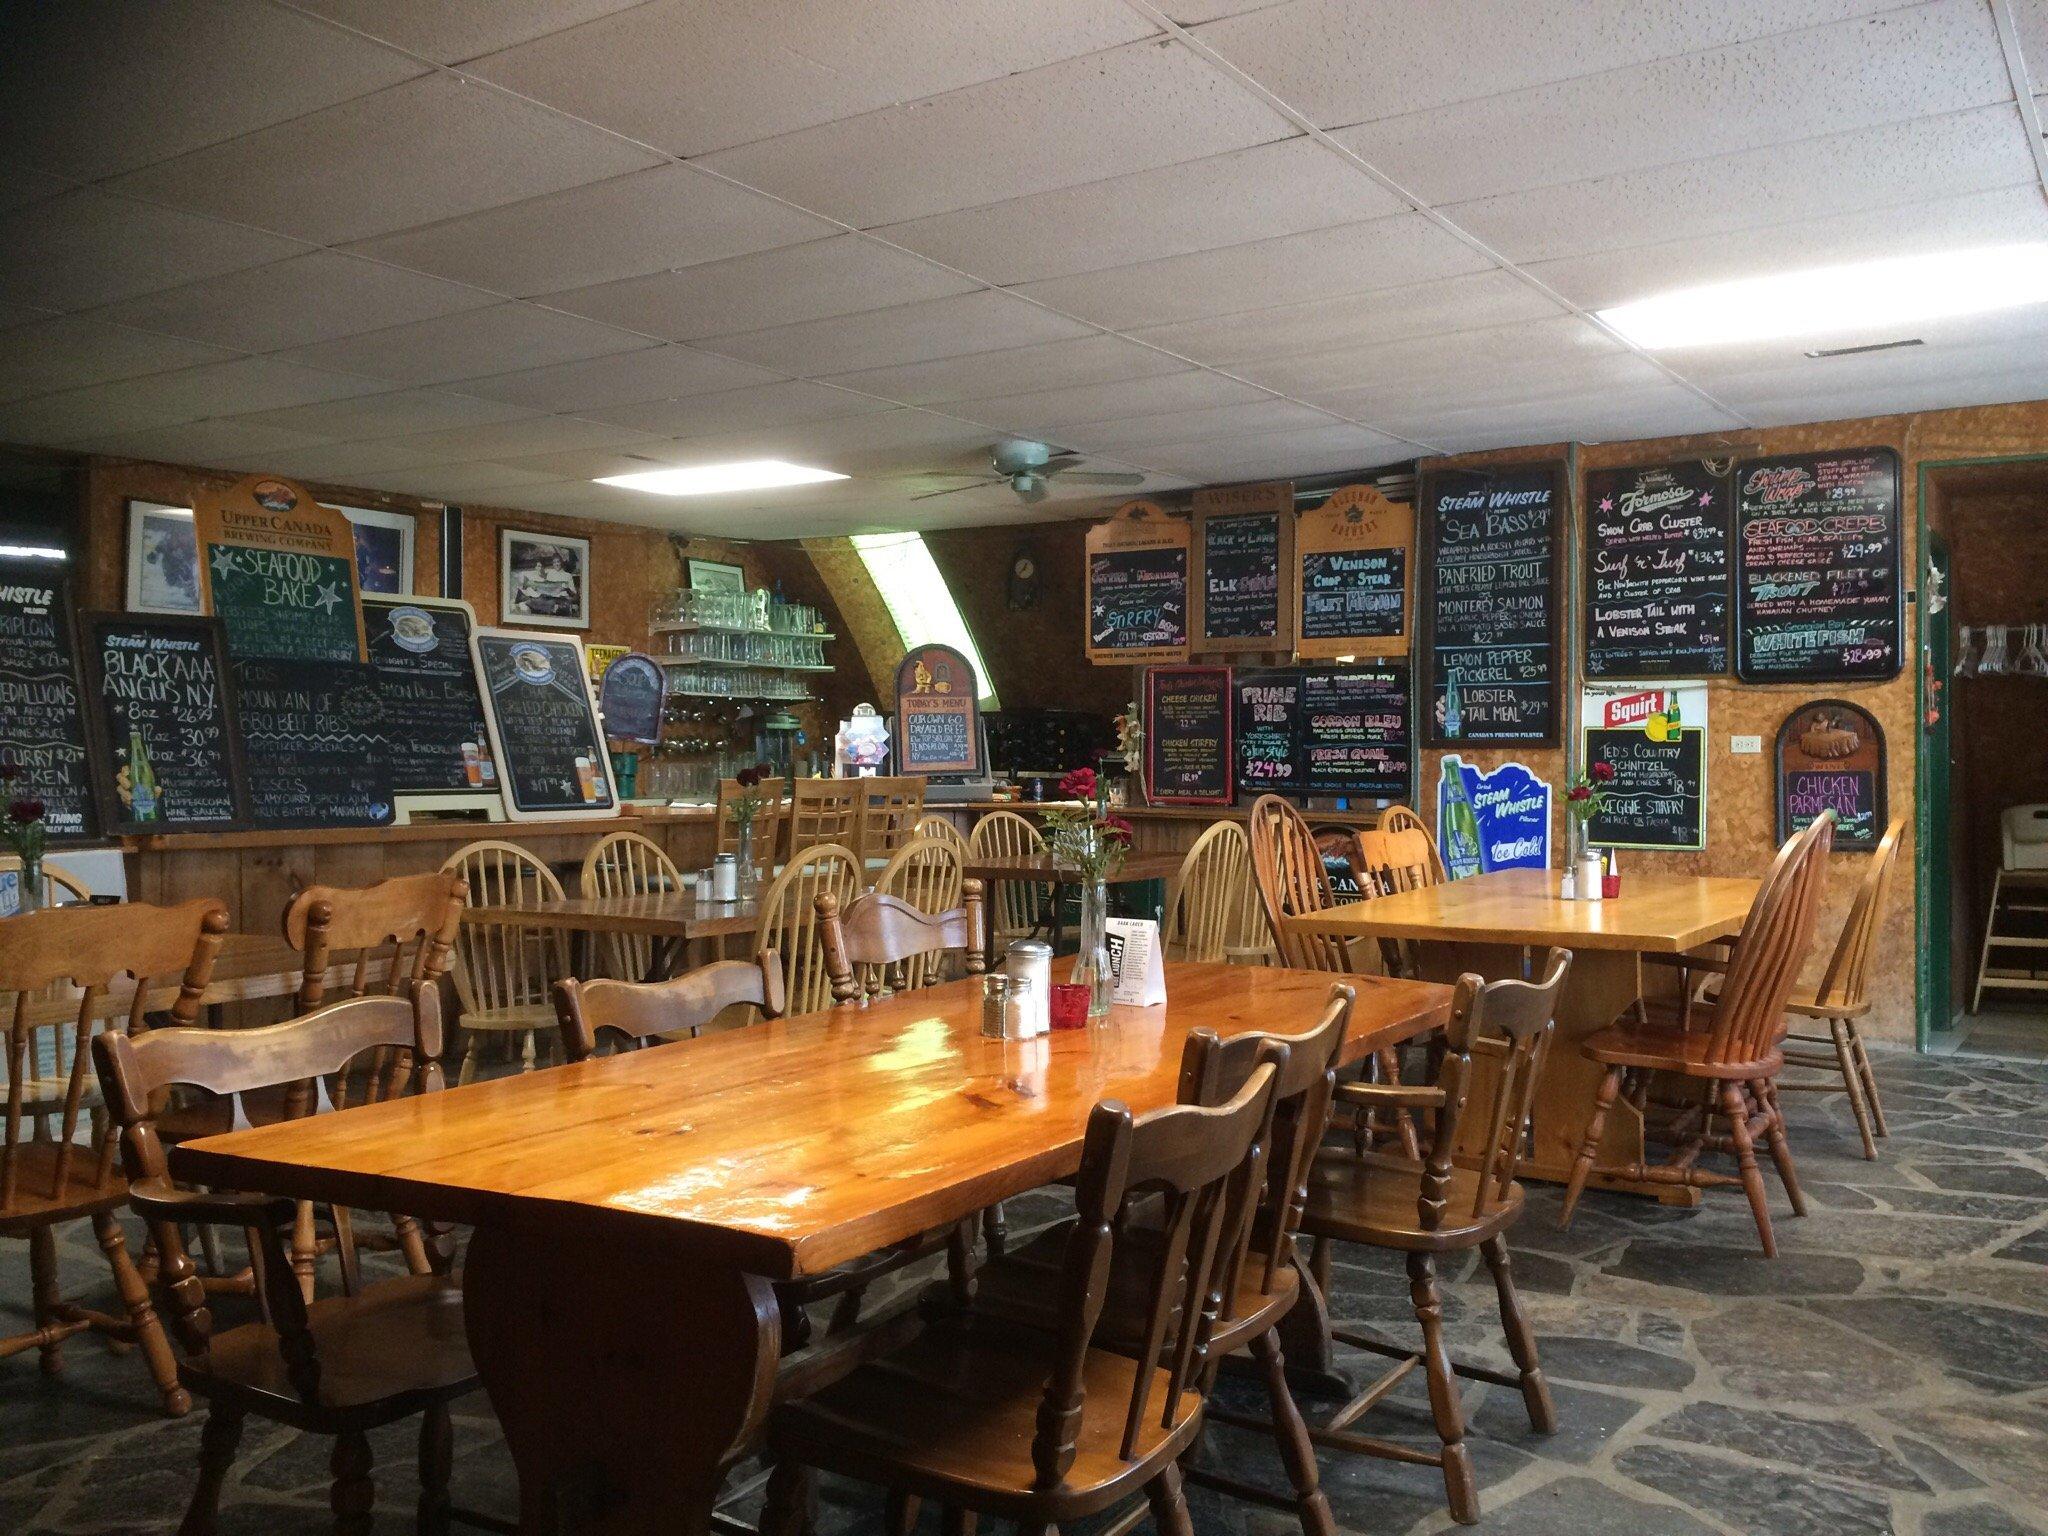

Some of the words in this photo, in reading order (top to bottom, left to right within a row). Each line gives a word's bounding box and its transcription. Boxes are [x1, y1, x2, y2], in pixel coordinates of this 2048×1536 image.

[1439, 495, 1485, 512] STEAM
[1490, 489, 1553, 508] WHISTLE
[1620, 486, 1695, 517] Formosa
[222, 510, 268, 529] UPPER
[271, 516, 333, 536] CANADA
[1443, 519, 1480, 543] SEA
[1487, 513, 1529, 537] BASS
[1598, 523, 1625, 537] SNOW
[1630, 517, 1653, 534] CRAB
[1660, 513, 1703, 531] CLUSTER
[1746, 518, 1818, 538] SEAFOOD
[1823, 515, 1884, 533] CREPE
[225, 530, 276, 544] BREWING
[280, 535, 332, 551] COMPANY
[242, 549, 322, 584] SEAFOOD
[1330, 556, 1387, 571] VENISON
[1594, 550, 1629, 580] Surf
[1652, 547, 1687, 575] Turf
[1313, 574, 1341, 588] CHOP
[1358, 571, 1391, 587] STEAK
[1440, 565, 1496, 586] PANFRIED
[1501, 562, 1543, 581] TROUT
[1749, 570, 1820, 585] BLACKENED
[1827, 568, 1870, 581] FILET
[1873, 568, 1889, 578] OF
[263, 577, 317, 610] BAKE
[1210, 578, 1238, 593] ELK
[1751, 581, 1821, 602] TROUT
[1439, 597, 1494, 616] MONTEREY
[1498, 594, 1544, 612] SALMON
[1777, 600, 1796, 608] WITH
[1799, 598, 1806, 607] A
[1810, 596, 1860, 606] HOMEMADE
[1863, 595, 1891, 605] YUMMY
[1797, 605, 1837, 614] CHUTNEY
[1107, 607, 1161, 629] STIRFRY
[1595, 607, 1643, 622] LOBSTER
[1643, 602, 1665, 618] TAIL
[1671, 603, 1696, 617] WITH
[1521, 618, 1548, 629] SAUCE
[1597, 625, 1605, 639] A
[1609, 625, 1651, 639] VENISON
[1655, 620, 1688, 636] STEAK
[106, 634, 147, 650] STEAM
[151, 637, 201, 652] WHISTLE
[104, 650, 169, 681] BLACK
[1444, 651, 1483, 667] LEMON
[1487, 649, 1533, 667] PEPPER
[1456, 666, 1513, 683] PICKEREL
[103, 673, 181, 704] ANGUS
[1242, 686, 1297, 705] PRIME
[1464, 687, 1517, 704] LOBSTER
[907, 699, 939, 709] TODAY'S
[943, 699, 967, 708] MENU
[1162, 694, 1188, 704] CHEESE
[1190, 693, 1218, 703] CHICKEN
[1611, 692, 1658, 723] Squirt
[240, 711, 273, 731] BBQ
[316, 713, 349, 733] RIBS
[1254, 703, 1288, 722] RIB
[1312, 714, 1361, 729] CORDON
[1365, 714, 1402, 729] BLEU
[1466, 706, 1490, 723] TAIL
[1493, 705, 1522, 723] MEAL
[1162, 738, 1189, 748] CHICKEN
[1191, 737, 1219, 748] STIRFRY
[1635, 743, 1681, 759] COUNTRY
[4, 747, 53, 768] CURRY
[1312, 748, 1349, 761] FRESH
[1351, 747, 1390, 760] QUAIL
[1246, 760, 1293, 778] $24.99
[1611, 760, 1670, 772] SCHNITZEL
[1797, 775, 1860, 797] CHICKEN
[1474, 787, 1511, 810] STEAM
[1496, 795, 1545, 819] WHISTLE
[1598, 799, 1643, 816] VEGGIE
[1790, 794, 1857, 817] PARMESAN
[1492, 840, 1512, 862] Ice
[1514, 835, 1544, 860] Cold
